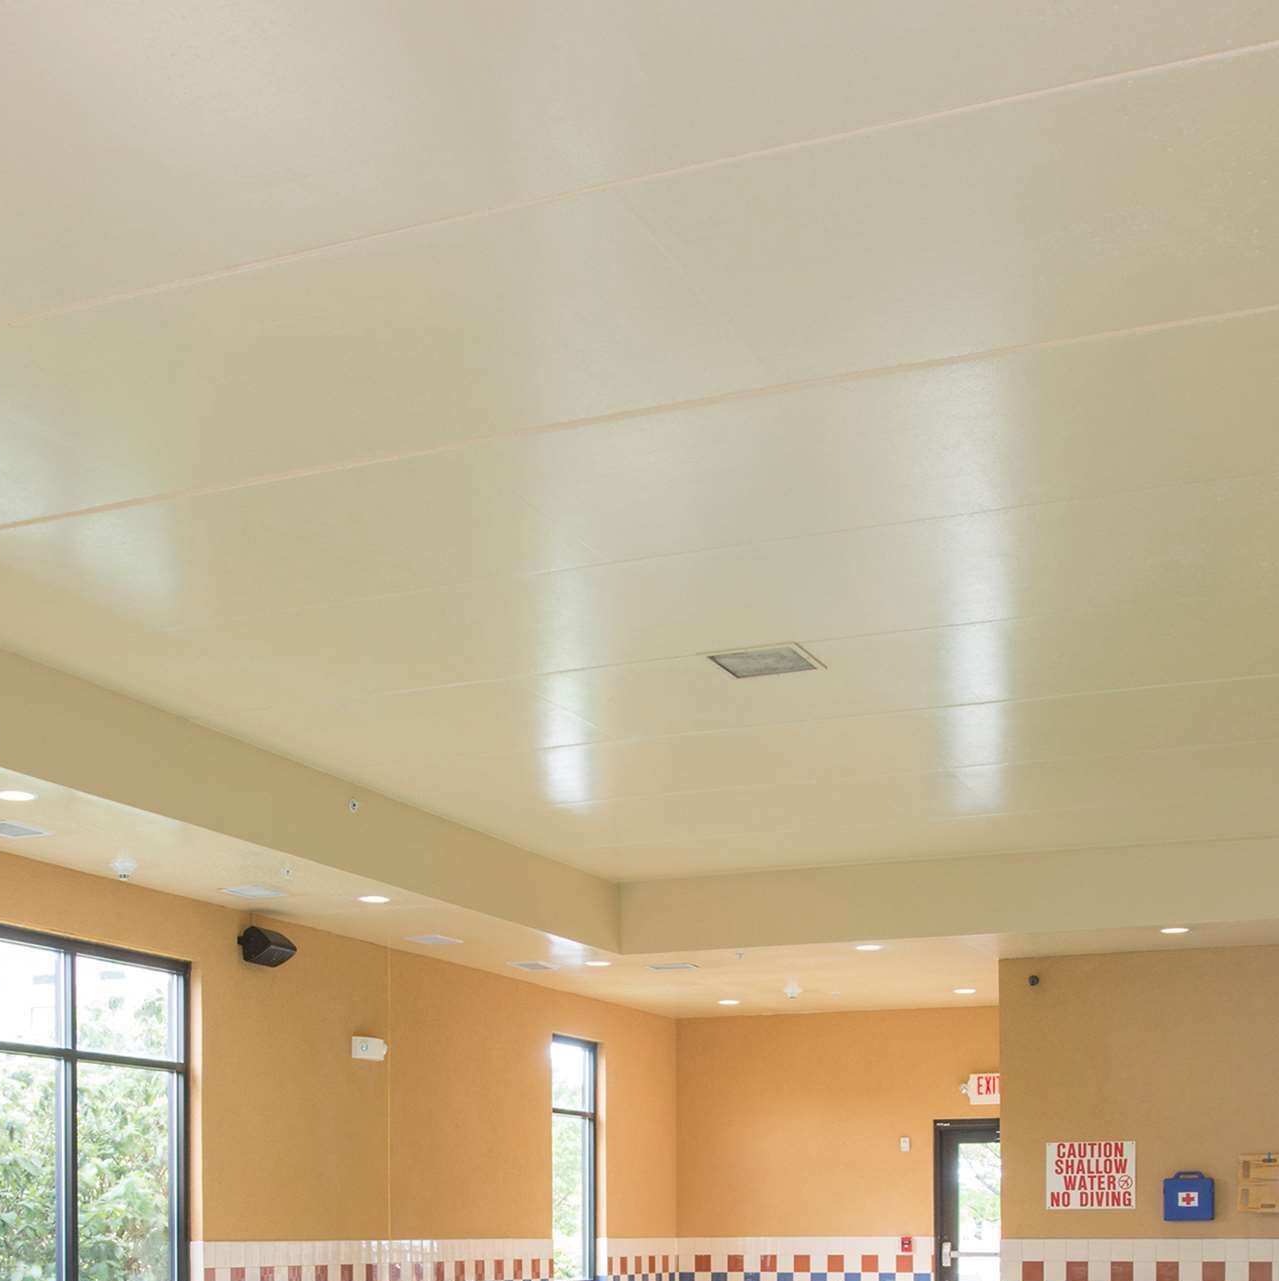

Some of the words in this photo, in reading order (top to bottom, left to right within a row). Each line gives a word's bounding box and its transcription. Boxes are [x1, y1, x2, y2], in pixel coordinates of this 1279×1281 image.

[1057, 1142, 1124, 1159] CAUTION
[1055, 1159, 1128, 1175] SHALLOW
[1063, 1175, 1117, 1191] WATER
[1050, 1191, 1071, 1208] NO
[1079, 1191, 1132, 1208] DIVING
